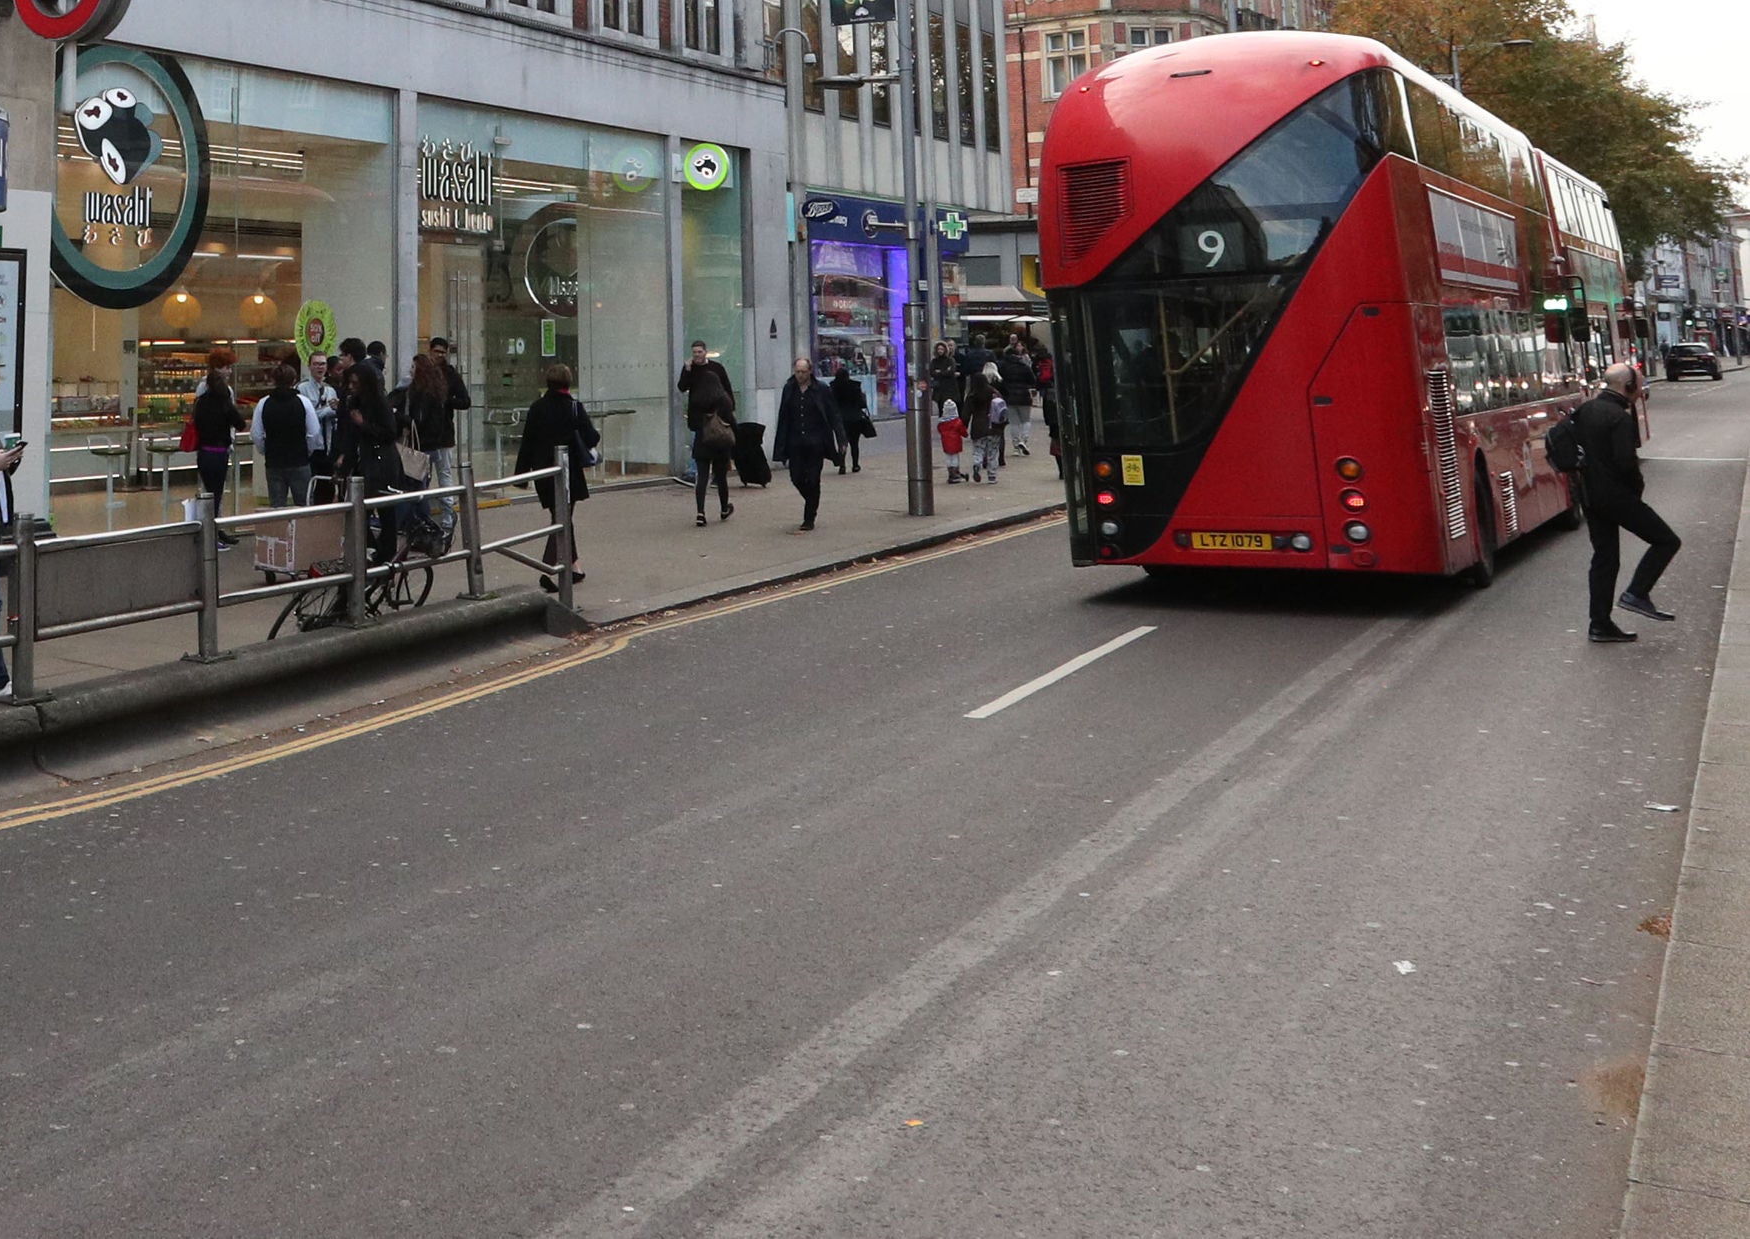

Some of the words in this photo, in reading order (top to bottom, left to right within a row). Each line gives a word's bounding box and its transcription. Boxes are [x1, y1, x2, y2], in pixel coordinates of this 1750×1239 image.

[422, 150, 493, 206] wasabi
[84, 186, 152, 226] wasabi
[422, 206, 450, 228] sushi
[1198, 230, 1225, 267] 9
[1201, 534, 1230, 547] LTZ
[1231, 536, 1263, 548] 1079
